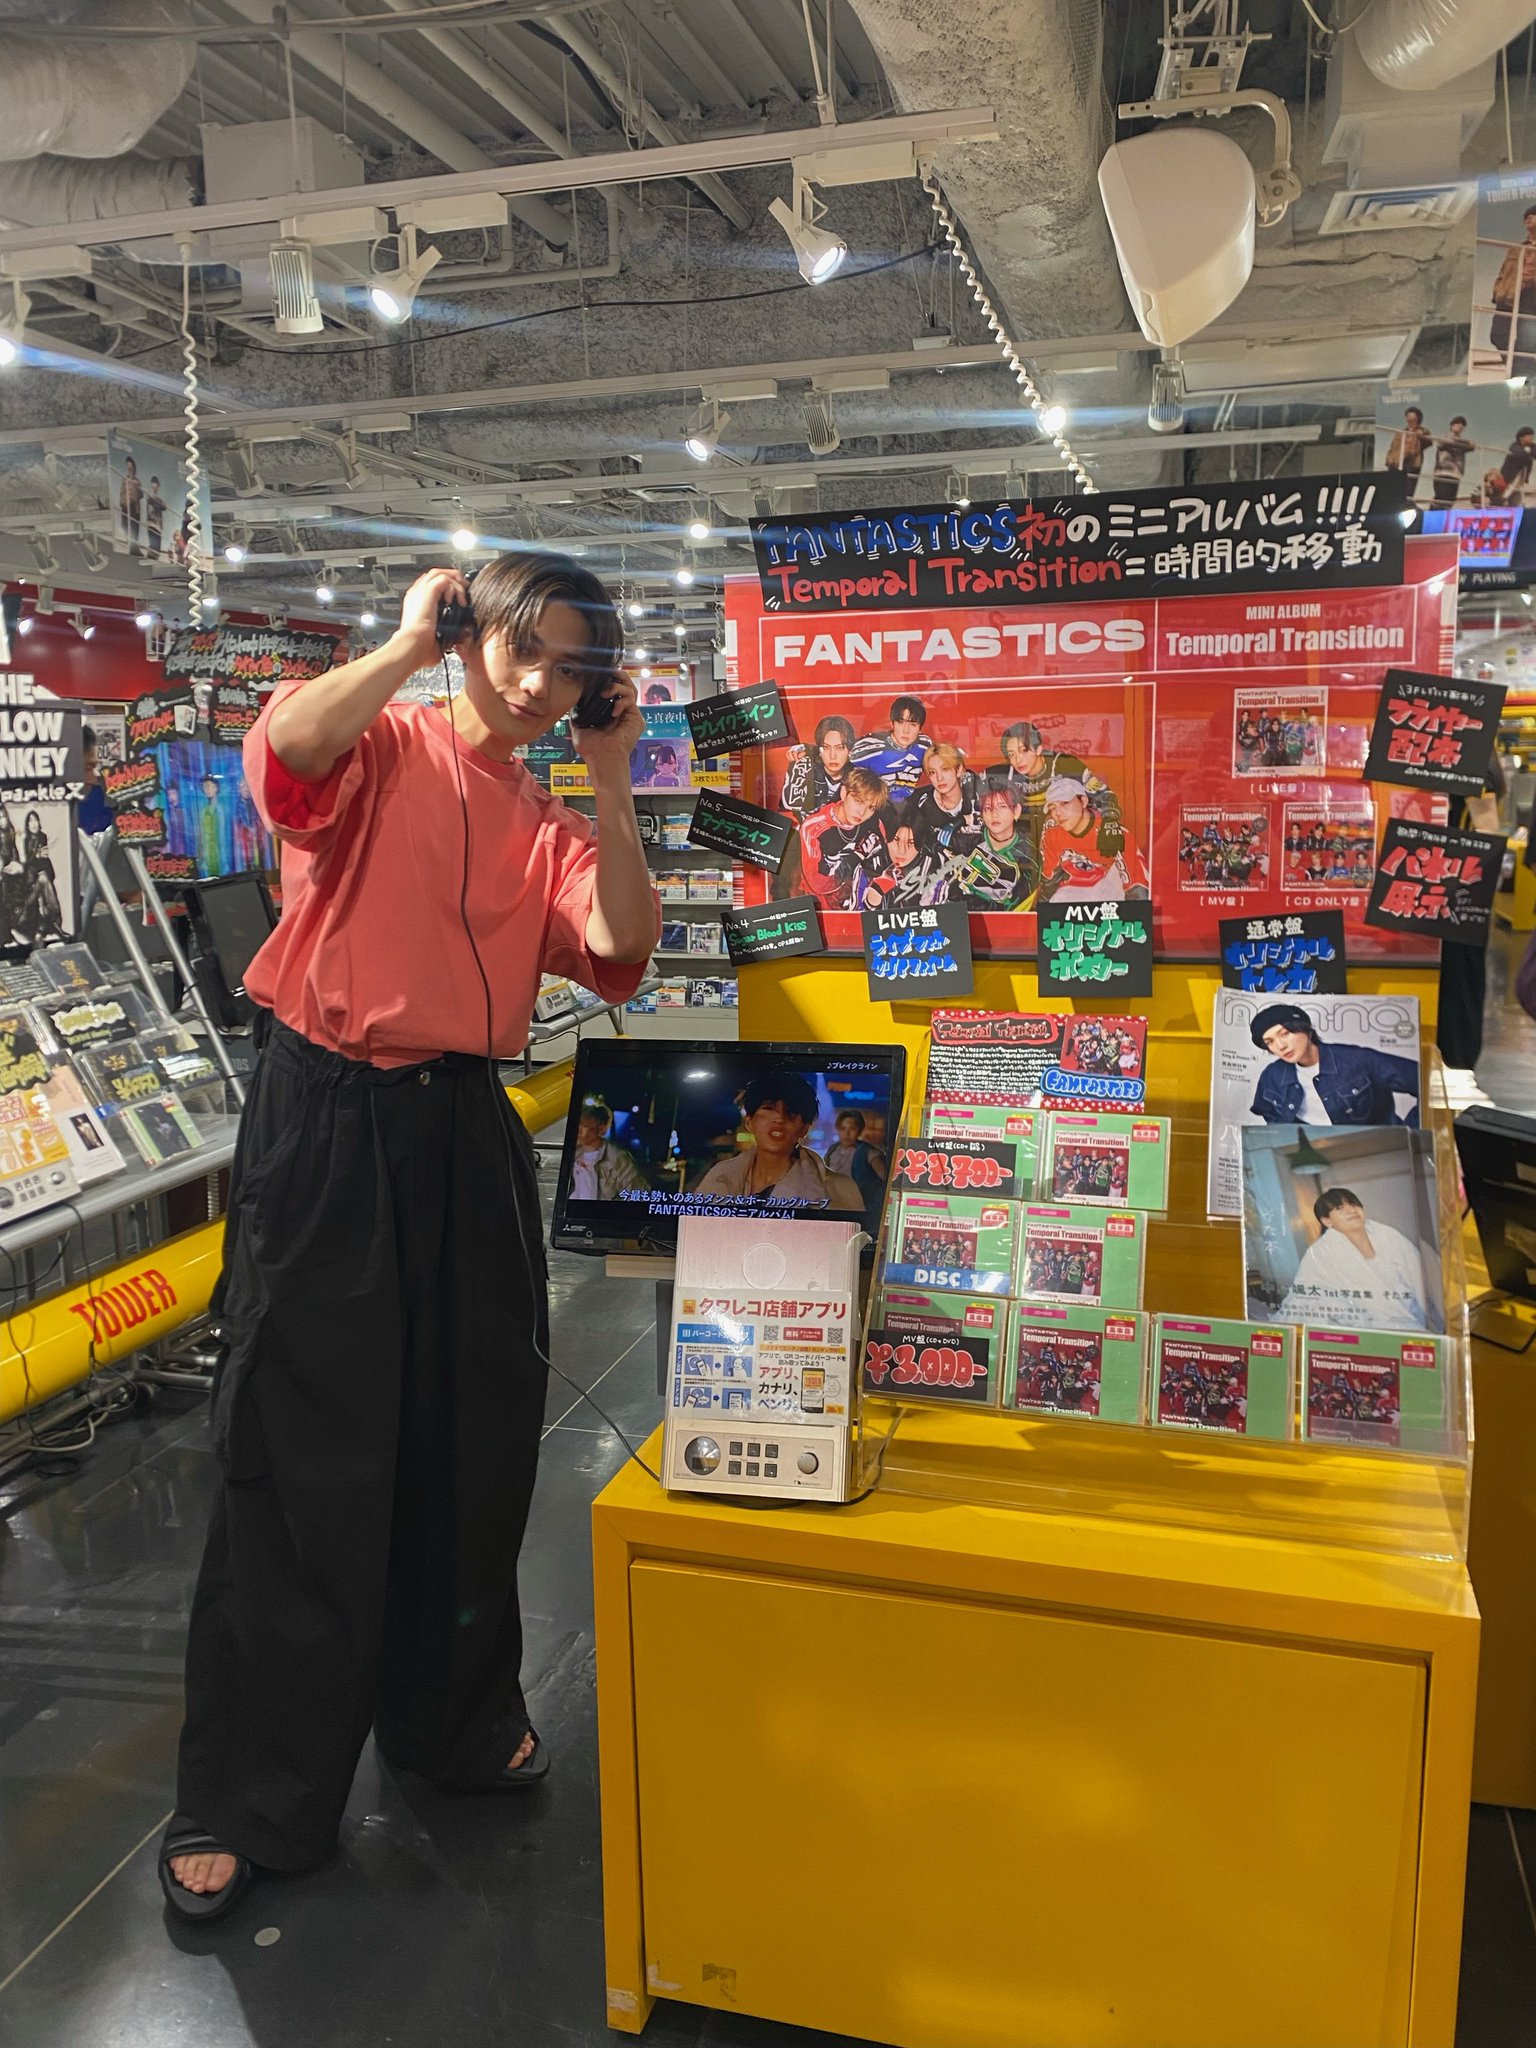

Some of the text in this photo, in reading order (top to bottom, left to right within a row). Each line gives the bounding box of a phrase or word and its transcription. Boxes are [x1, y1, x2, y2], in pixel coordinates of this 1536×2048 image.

[768, 559, 918, 607] Temporal
[1246, 603, 1321, 620] MINI ALBUM
[774, 619, 1145, 667] FANTASTICS
[1166, 625, 1404, 656] Temporal Transition
[1238, 695, 1319, 706] Temporal Transition
[1387, 698, 1483, 735] フライヤー
[1183, 812, 1220, 822] Temporal
[1380, 846, 1483, 885] パネル
[1379, 880, 1452, 918] 展示
[877, 908, 938, 930] LIVE盤
[1065, 902, 1120, 921] MV盤
[726, 919, 749, 931] No.4
[756, 923, 783, 941] Blood
[784, 920, 807, 933] Kiss
[1246, 916, 1304, 940] 通常盤
[1043, 920, 1147, 952] オリジナル
[1225, 936, 1336, 970] オリジナル
[1050, 951, 1129, 982] ポスター
[934, 1128, 999, 1139] Temporal Transition
[1055, 1135, 1124, 1146] Temporal Transition
[906, 1218, 937, 1228] Temporal
[1027, 1227, 1098, 1241] Temporal Transition
[914, 1268, 961, 1287] DISC
[68, 1268, 178, 1346] TOWER
[699, 1297, 847, 1320] タワレコ店舗アプリ
[887, 1319, 955, 1333] Temporal Transition
[1022, 1333, 1095, 1347] Temporal Transition
[1164, 1347, 1240, 1363] Temporal Transition
[1311, 1358, 1391, 1374] Temporal Transition
[759, 1382, 798, 1395] カナリ、
